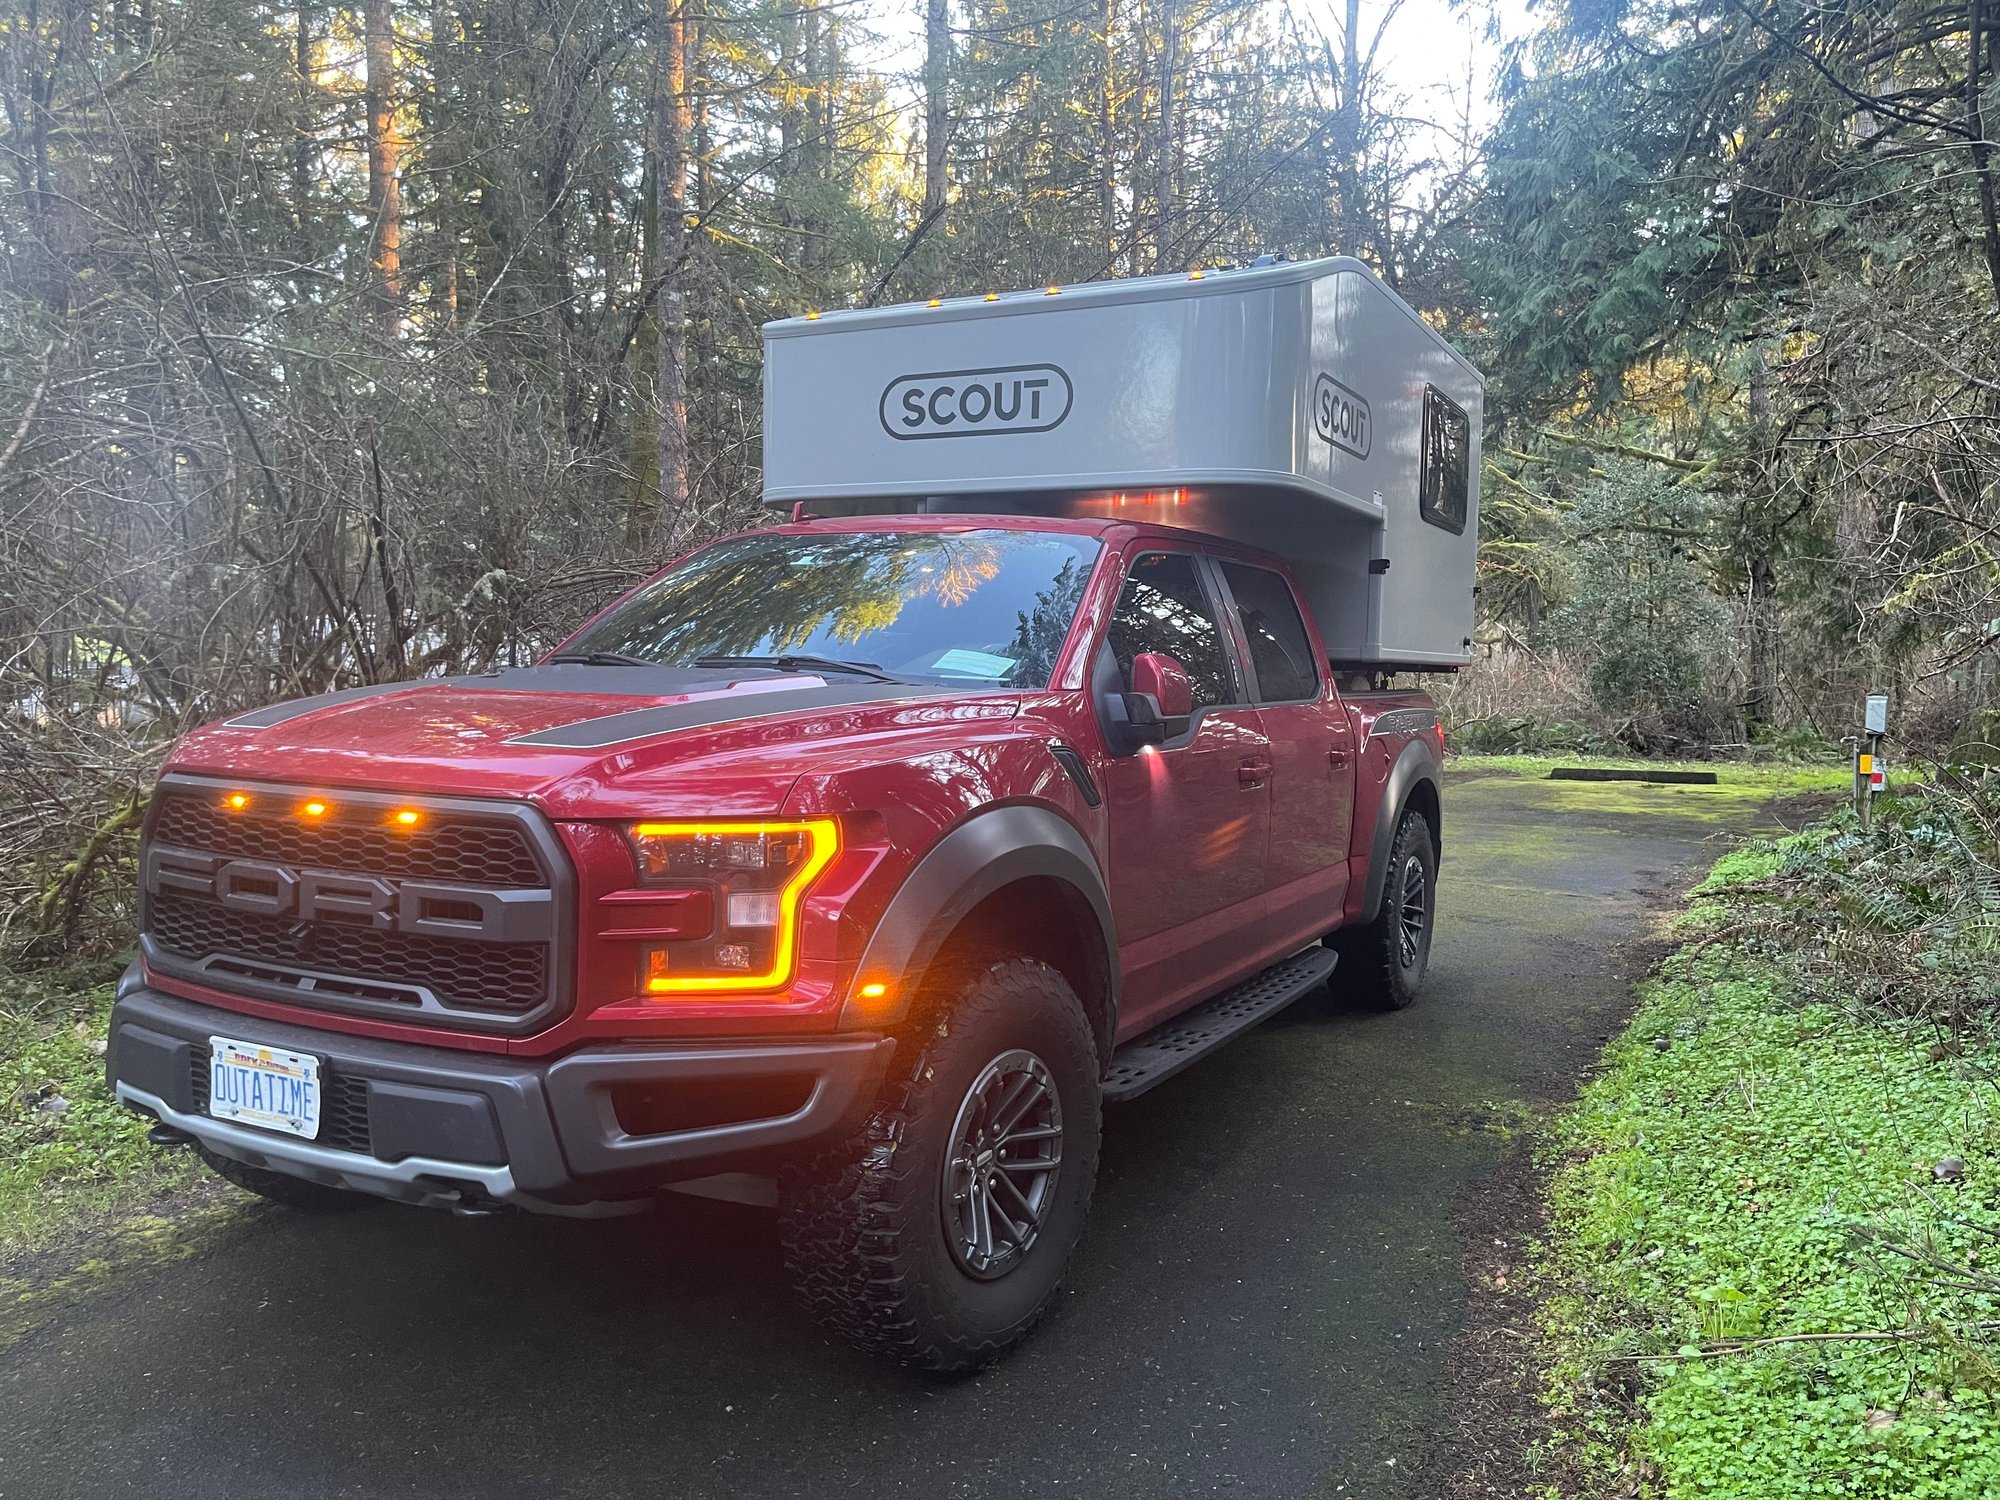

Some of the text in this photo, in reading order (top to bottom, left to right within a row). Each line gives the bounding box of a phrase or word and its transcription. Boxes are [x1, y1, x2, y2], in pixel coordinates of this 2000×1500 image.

[902, 378, 1049, 428] SCOUT
[1321, 388, 1367, 449] SCOUT
[147, 847, 512, 942] FORD
[214, 1062, 314, 1122] OUTATIME
